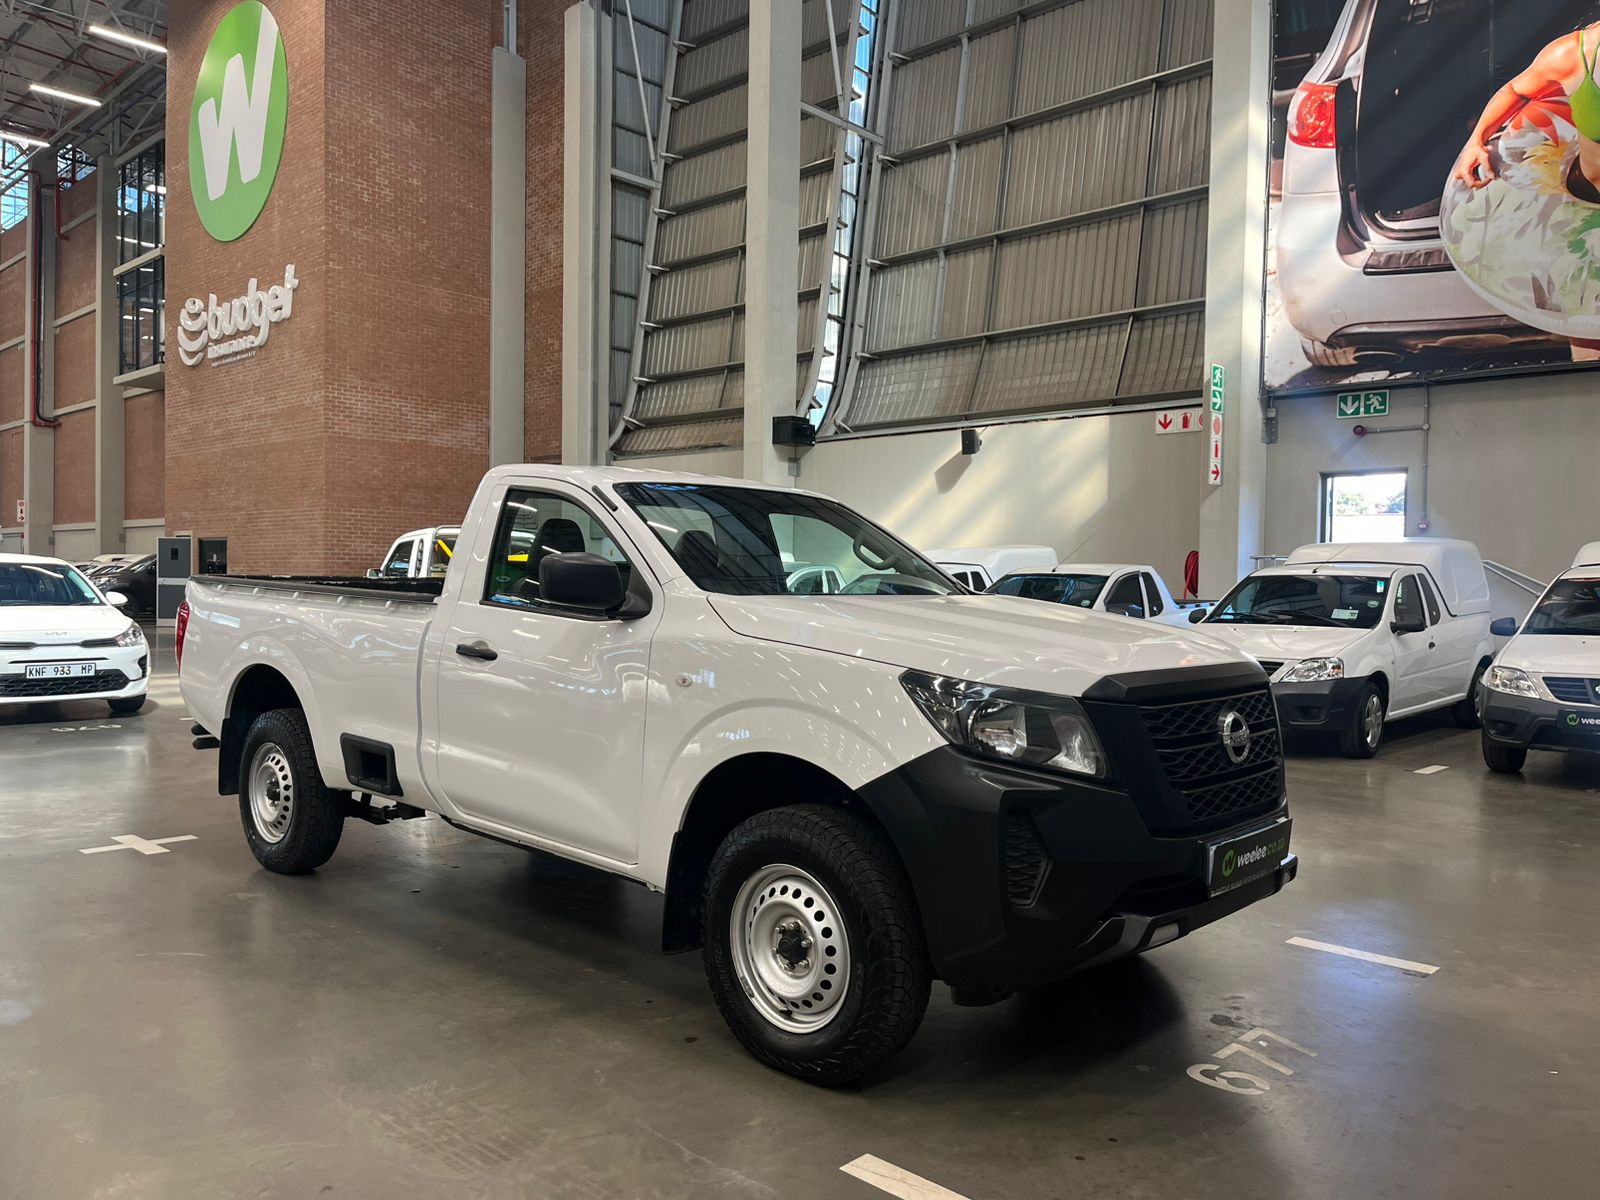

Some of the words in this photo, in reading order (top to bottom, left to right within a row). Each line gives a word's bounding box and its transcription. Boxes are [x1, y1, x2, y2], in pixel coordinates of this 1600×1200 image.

[207, 264, 299, 346] budget
[28, 667, 47, 677] KNF
[53, 665, 71, 676] 933
[81, 664, 93, 675] MP
